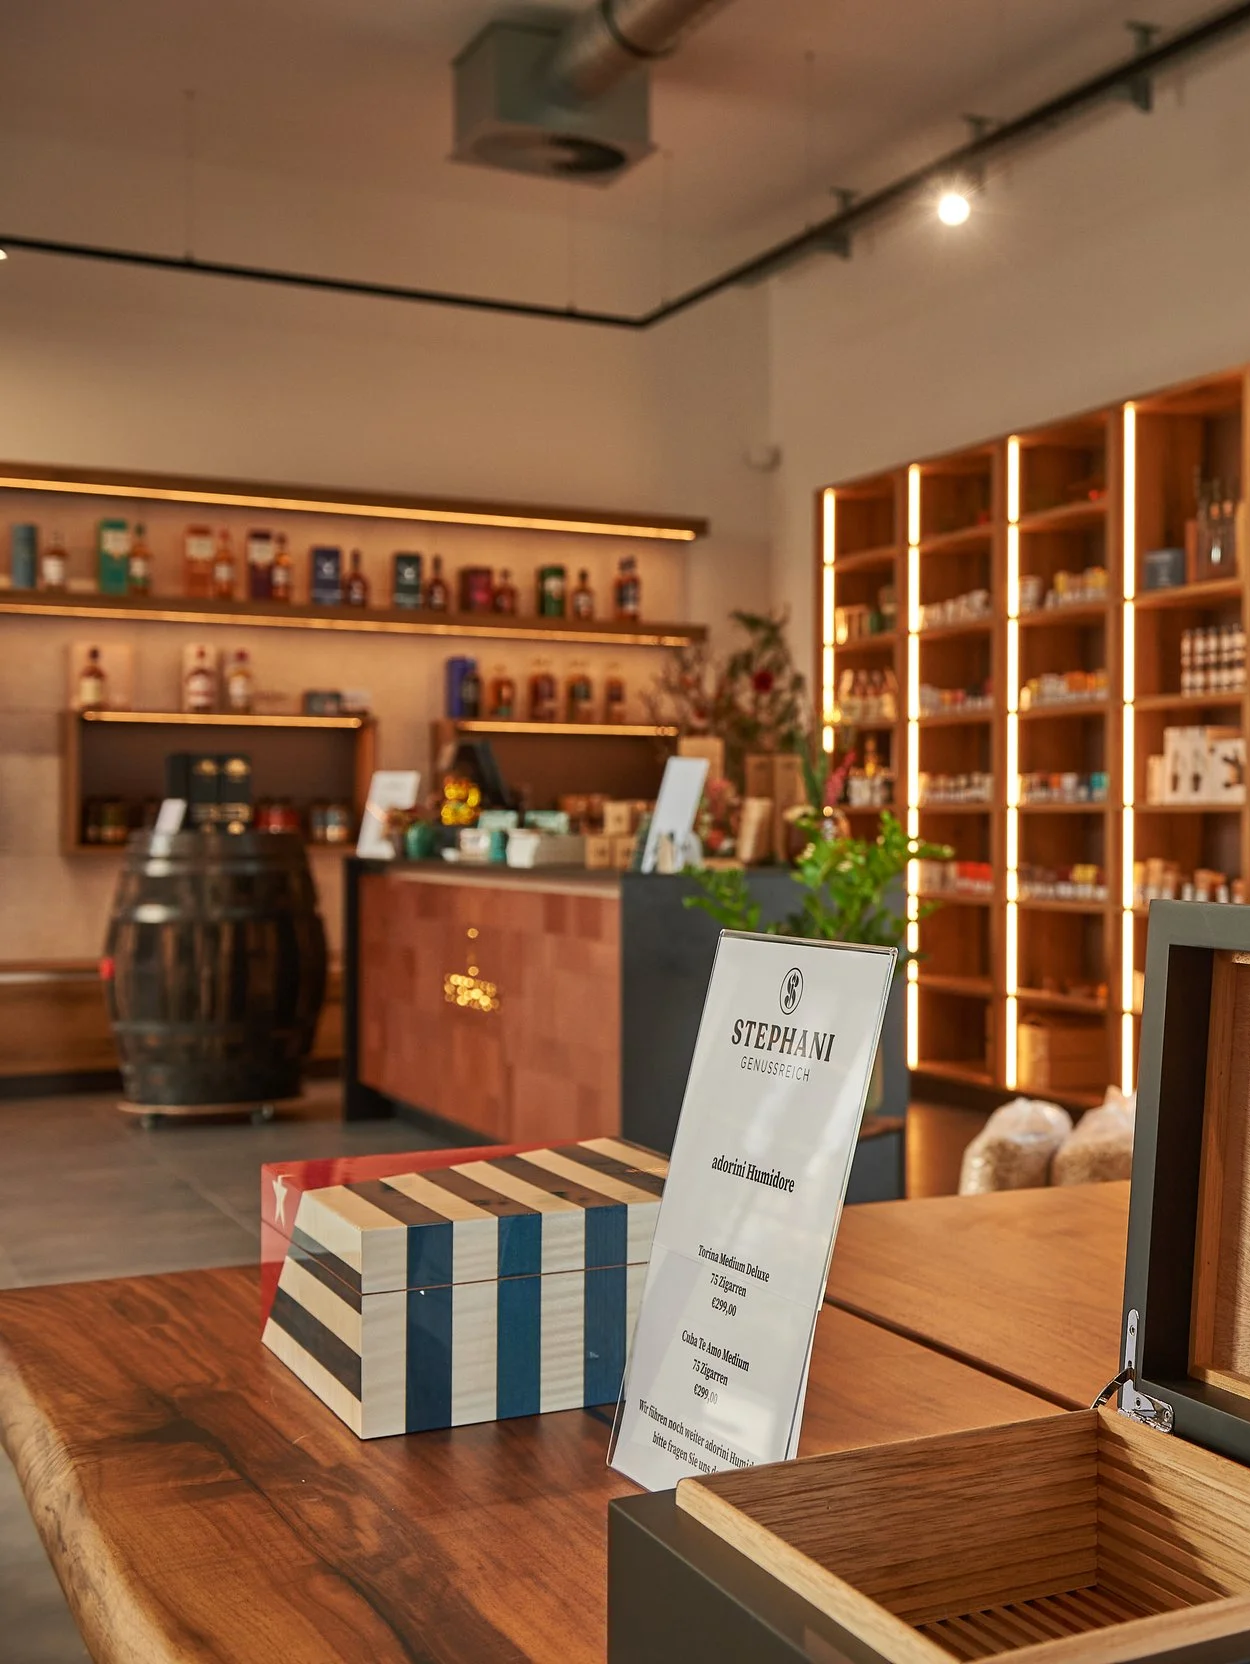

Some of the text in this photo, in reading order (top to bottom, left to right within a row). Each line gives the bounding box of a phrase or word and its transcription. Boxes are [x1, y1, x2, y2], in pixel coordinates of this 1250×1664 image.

[731, 1018, 836, 1062] STEPHANI
[740, 1056, 811, 1082] GENUSSREICH
[711, 1154, 795, 1193] adorini Humidore
[698, 1244, 770, 1283] Torina Medium Deluxe
[710, 1272, 747, 1298] 75 Zigarren
[711, 1296, 737, 1317] €299,00
[681, 1329, 750, 1372] Cuba Te Amo Medium
[692, 1358, 729, 1387] 75 Zigarren
[639, 1398, 649, 1414] Wir
[648, 1404, 669, 1427] führen
[667, 1418, 685, 1436] noch
[684, 1428, 706, 1448] weiter
[704, 1438, 730, 1462] adorini
[652, 1430, 667, 1449] bitte
[667, 1439, 688, 1461] fragen
[687, 1451, 699, 1469] Sie
[698, 1459, 711, 1475] uns
